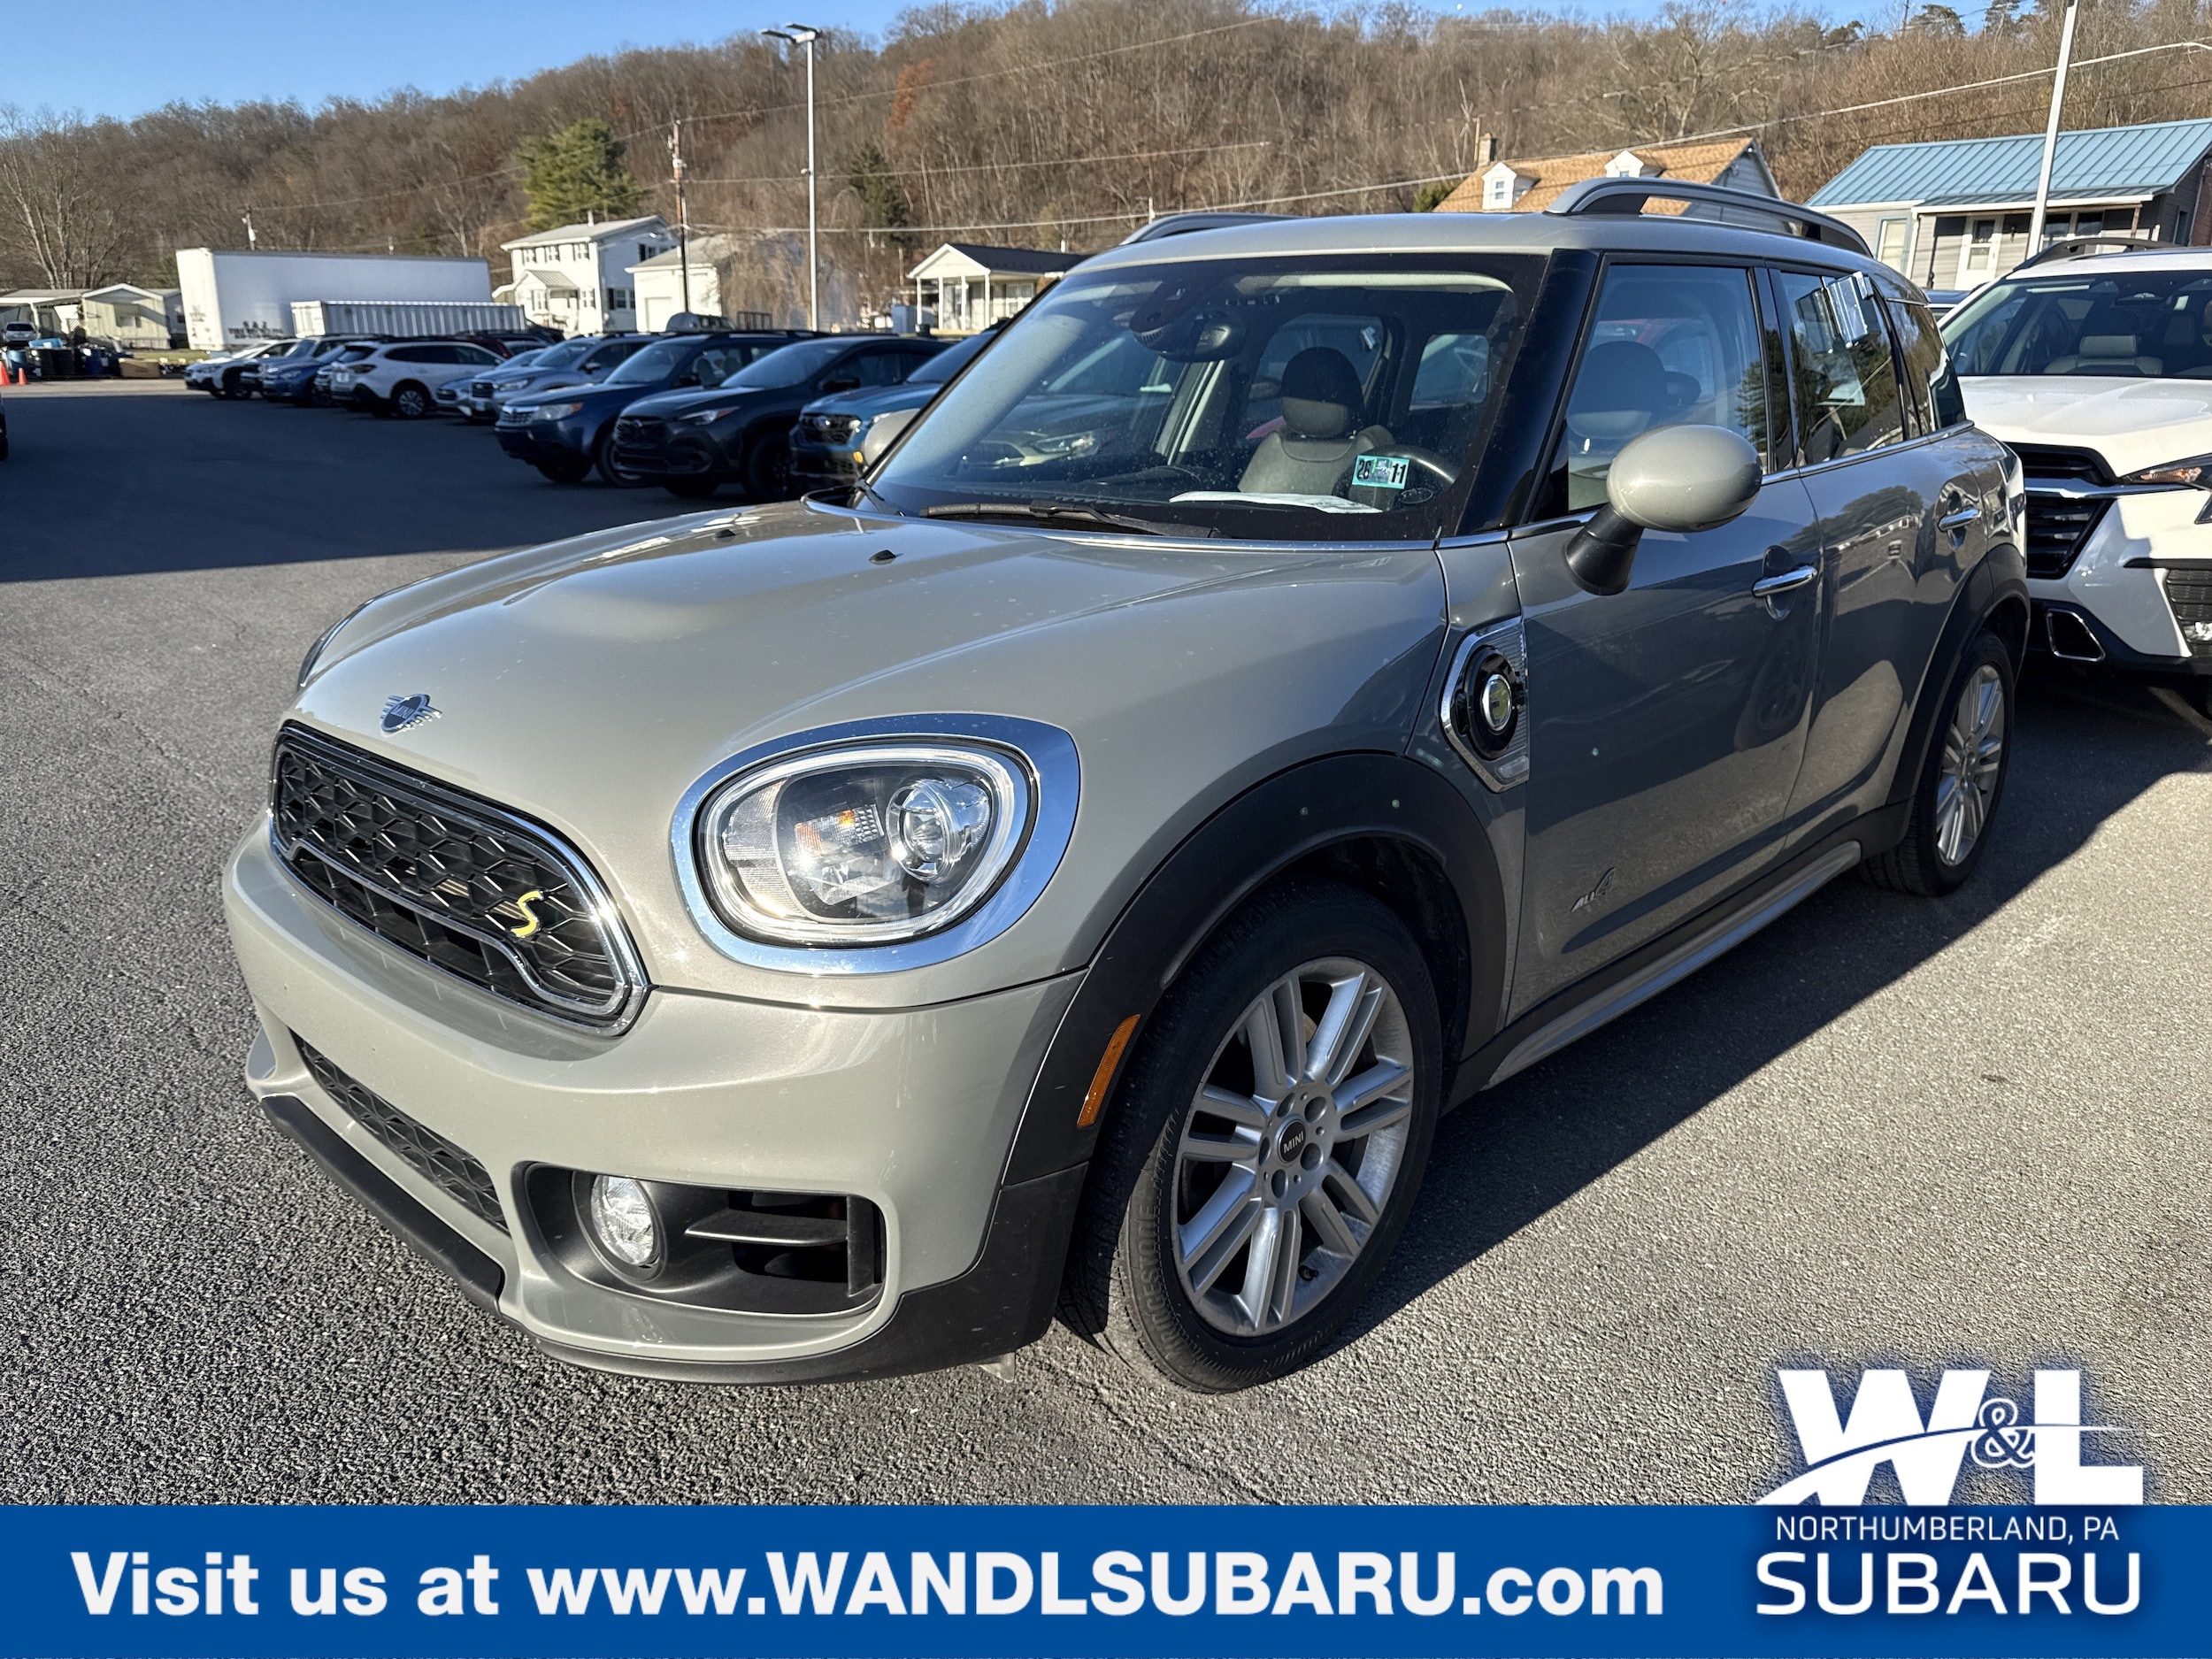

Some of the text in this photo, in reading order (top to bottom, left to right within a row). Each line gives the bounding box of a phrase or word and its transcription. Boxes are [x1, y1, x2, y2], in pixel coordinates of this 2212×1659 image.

[1356, 458, 1407, 483] 26 11
[511, 890, 544, 939] S
[1284, 1131, 1304, 1153] MINI
